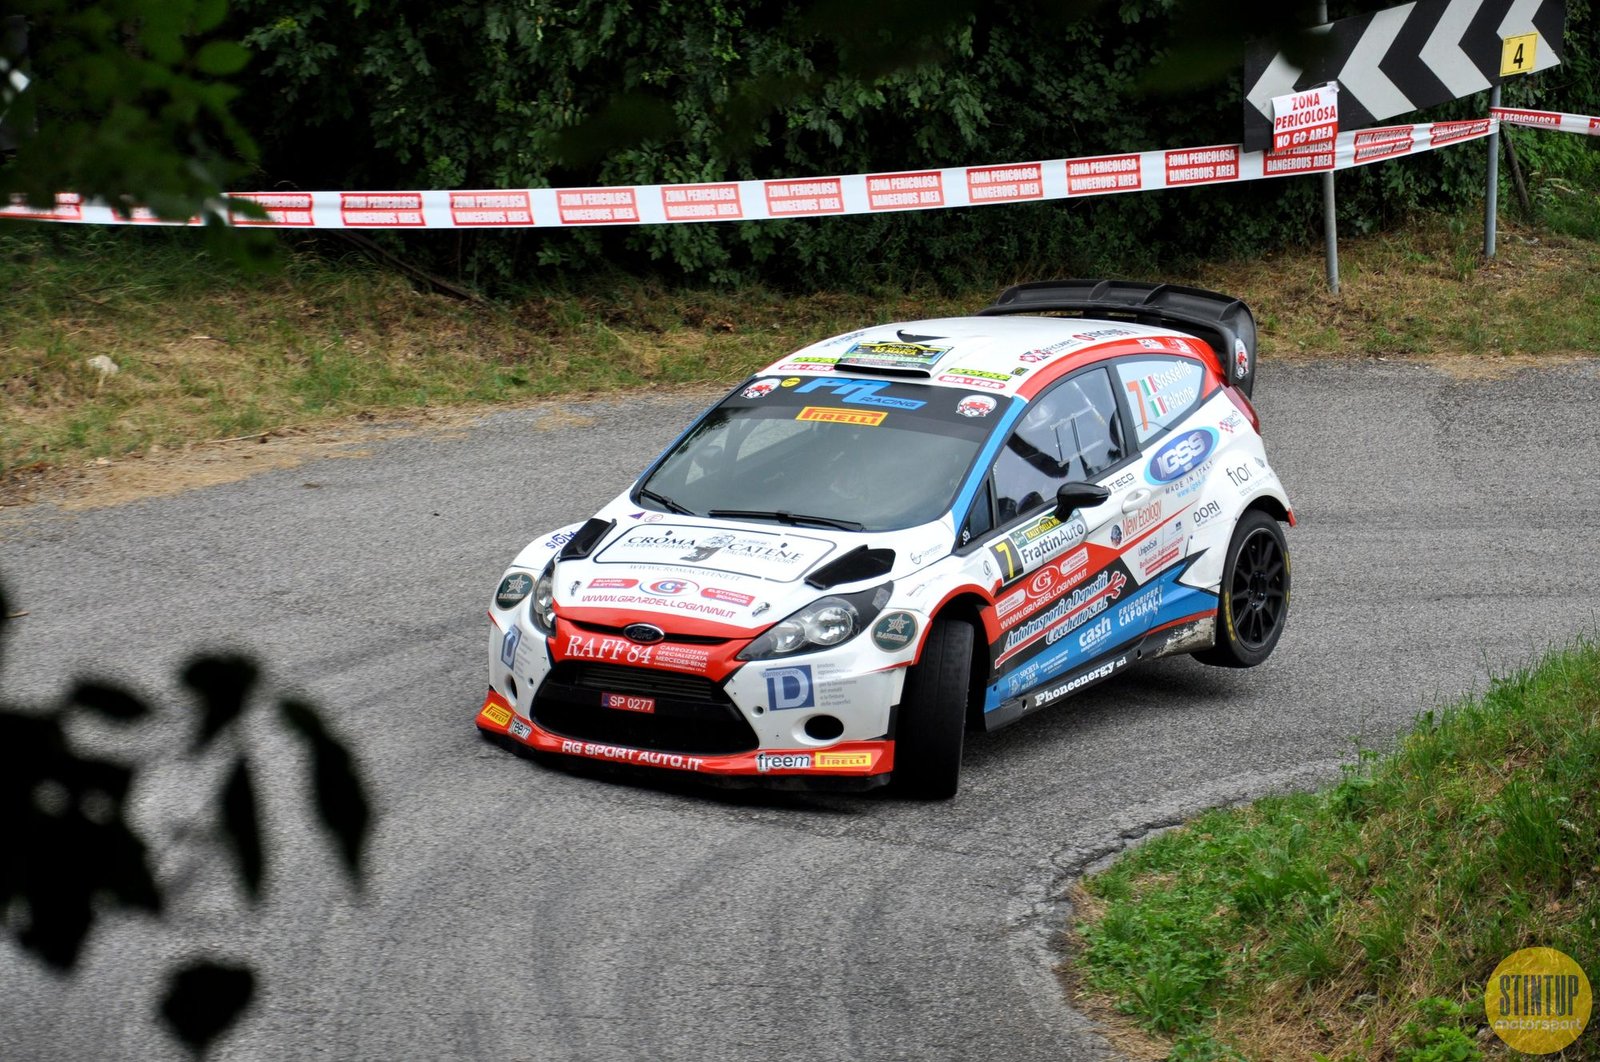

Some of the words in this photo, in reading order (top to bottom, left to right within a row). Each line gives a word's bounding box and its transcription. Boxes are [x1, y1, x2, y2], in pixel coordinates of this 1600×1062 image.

[1513, 43, 1523, 69] 4
[1291, 92, 1320, 111] ZONA
[1275, 105, 1336, 130] PERICOLOSA
[1276, 135, 1290, 148] NO
[1292, 131, 1307, 144] GO
[1308, 125, 1334, 142] AREA
[1069, 163, 1090, 176] ZONA
[1090, 158, 1137, 174] PERICOLOSA
[1169, 154, 1188, 167] ZONA
[1188, 149, 1236, 165] PERICOLOSA
[1267, 156, 1312, 172] DANGEROUS
[1313, 154, 1333, 167] AREA
[970, 171, 991, 185] ZONA
[991, 167, 1038, 182] PERICOLOSA
[1070, 175, 1116, 191] DANGEROUS
[1117, 174, 1138, 187] AREA
[1169, 167, 1214, 182] DANGEROUS
[1215, 164, 1236, 178] AREA
[860, 396, 916, 408] RACING
[1126, 380, 1149, 431] 7
[800, 408, 884, 425] PIRELLI
[1165, 482, 1184, 495] MADE
[1186, 475, 1194, 485] IN
[1195, 459, 1214, 478] ITALY
[1121, 512, 1138, 539] New
[1139, 498, 1162, 528] Ecology
[627, 536, 696, 546] CROMA
[727, 542, 805, 561] CATENE
[1020, 524, 1084, 564] FrattinAuto
[994, 541, 1015, 579] 7
[582, 594, 737, 619] WWW.GIRARDELLOGIANNI.IT
[1003, 598, 1066, 653] Autotrasporti
[1072, 571, 1108, 606] Depositi
[631, 628, 655, 640] Ford
[1045, 607, 1090, 646] Cecchetto
[1078, 616, 1112, 647] cash
[657, 650, 708, 662] SPECIALIZZATA
[659, 645, 709, 656] CARROZZERIA
[655, 655, 707, 668] MERCEDES-BENZ
[1034, 660, 1116, 707] Phoneenergy
[1115, 656, 1128, 669] srl
[610, 695, 625, 707] SP
[627, 698, 653, 711] 0277
[484, 705, 510, 724] PIRELLI
[561, 740, 583, 754] RG
[584, 743, 638, 760] SPORT
[637, 751, 704, 771] AUTO.IT
[757, 752, 810, 772] freem
[820, 754, 867, 766] PIRELLI
